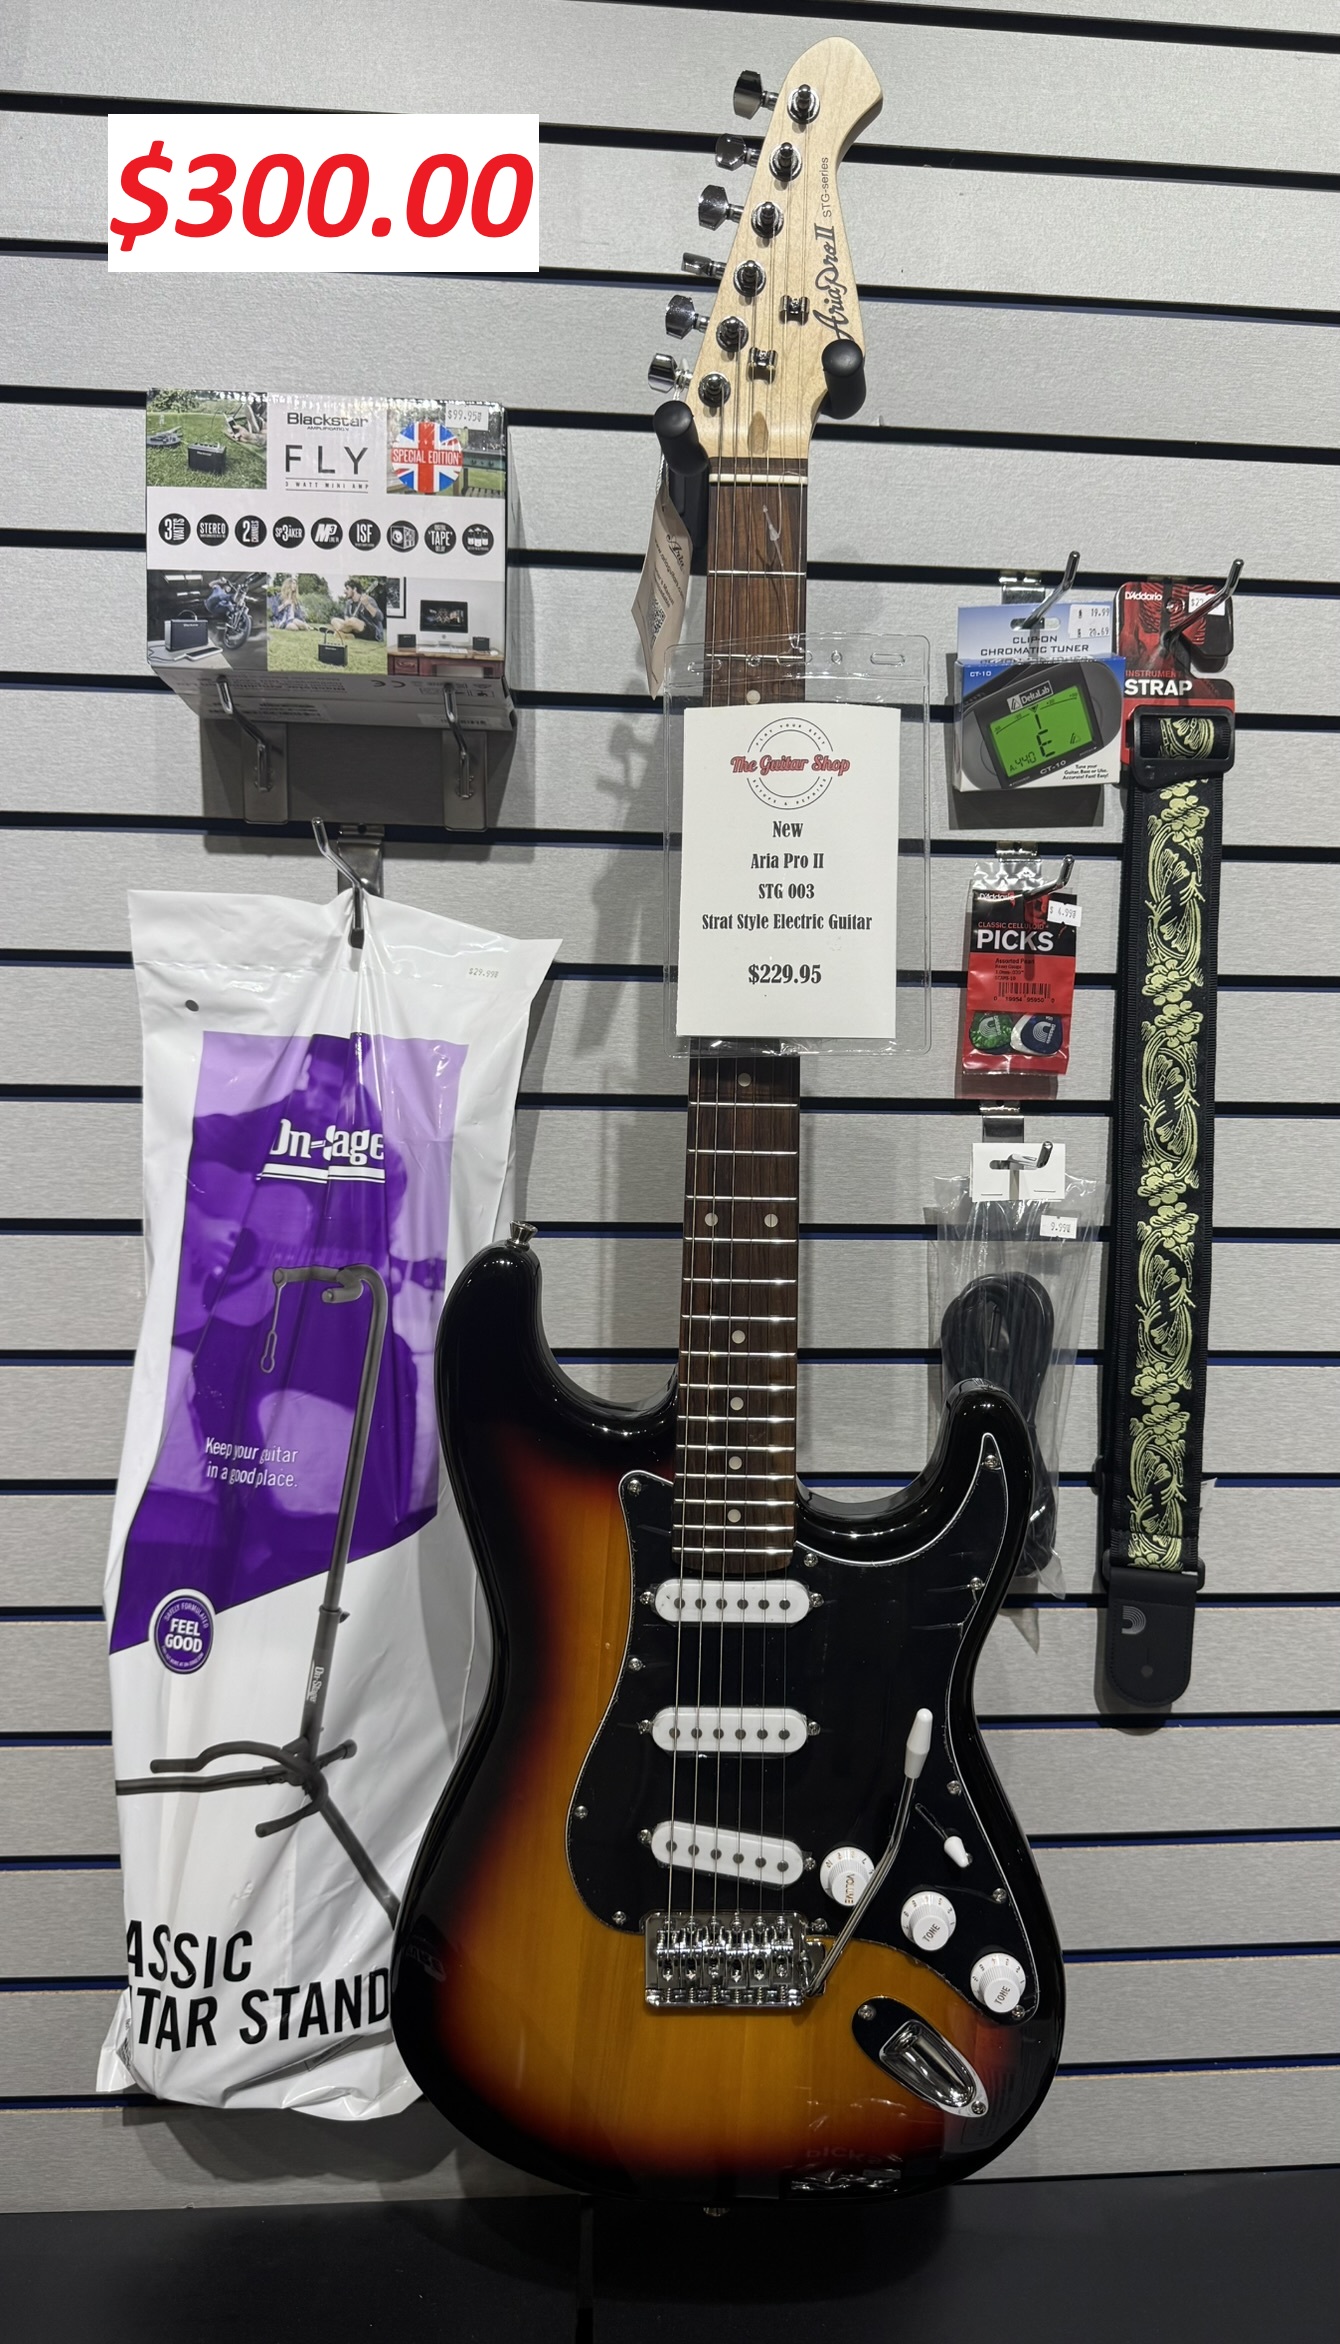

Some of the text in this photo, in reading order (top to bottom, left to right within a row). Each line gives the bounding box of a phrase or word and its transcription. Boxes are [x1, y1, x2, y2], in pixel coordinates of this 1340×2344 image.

[819, 157, 832, 218] STG-series
[815, 243, 847, 293] Pro
[812, 287, 854, 341] Aria
[287, 412, 369, 427] Blackstar
[285, 445, 368, 475] FLY
[393, 449, 459, 465] SPECIAL EDITION
[164, 518, 172, 541] 3
[173, 518, 185, 541] WATTS
[200, 522, 226, 534] STEREO
[242, 520, 250, 542] 2
[357, 523, 373, 543] ISF
[666, 534, 686, 571] Aria
[1124, 591, 1163, 601] D'Addario
[1012, 635, 1058, 645] CLIP-ON
[980, 645, 1089, 657] CHROMATIC TUNER
[1020, 686, 1050, 705] DeltaLab
[1124, 679, 1193, 696] STRAP
[730, 754, 850, 777] The Guitar Shop
[1039, 760, 1067, 775] CT-10
[773, 821, 803, 837] New
[751, 853, 824, 869] Aria Pro II
[758, 883, 815, 899] STG 003
[702, 914, 872, 931] Strat Style Electric Guitar
[978, 921, 1044, 930] CLASSIC CELLULOID
[977, 929, 1054, 951] PICKS
[748, 964, 822, 984] $229.95
[205, 1437, 298, 1464] Keep your guitar
[207, 1461, 298, 1488] in a good place.
[170, 1617, 200, 1636] FEEL
[165, 1634, 203, 1653] GOOD
[845, 1874, 854, 1904] VOLUME
[923, 1923, 940, 1943] TONE
[994, 1986, 1011, 2005] TONE
[130, 1967, 389, 2052] TAR STAND
